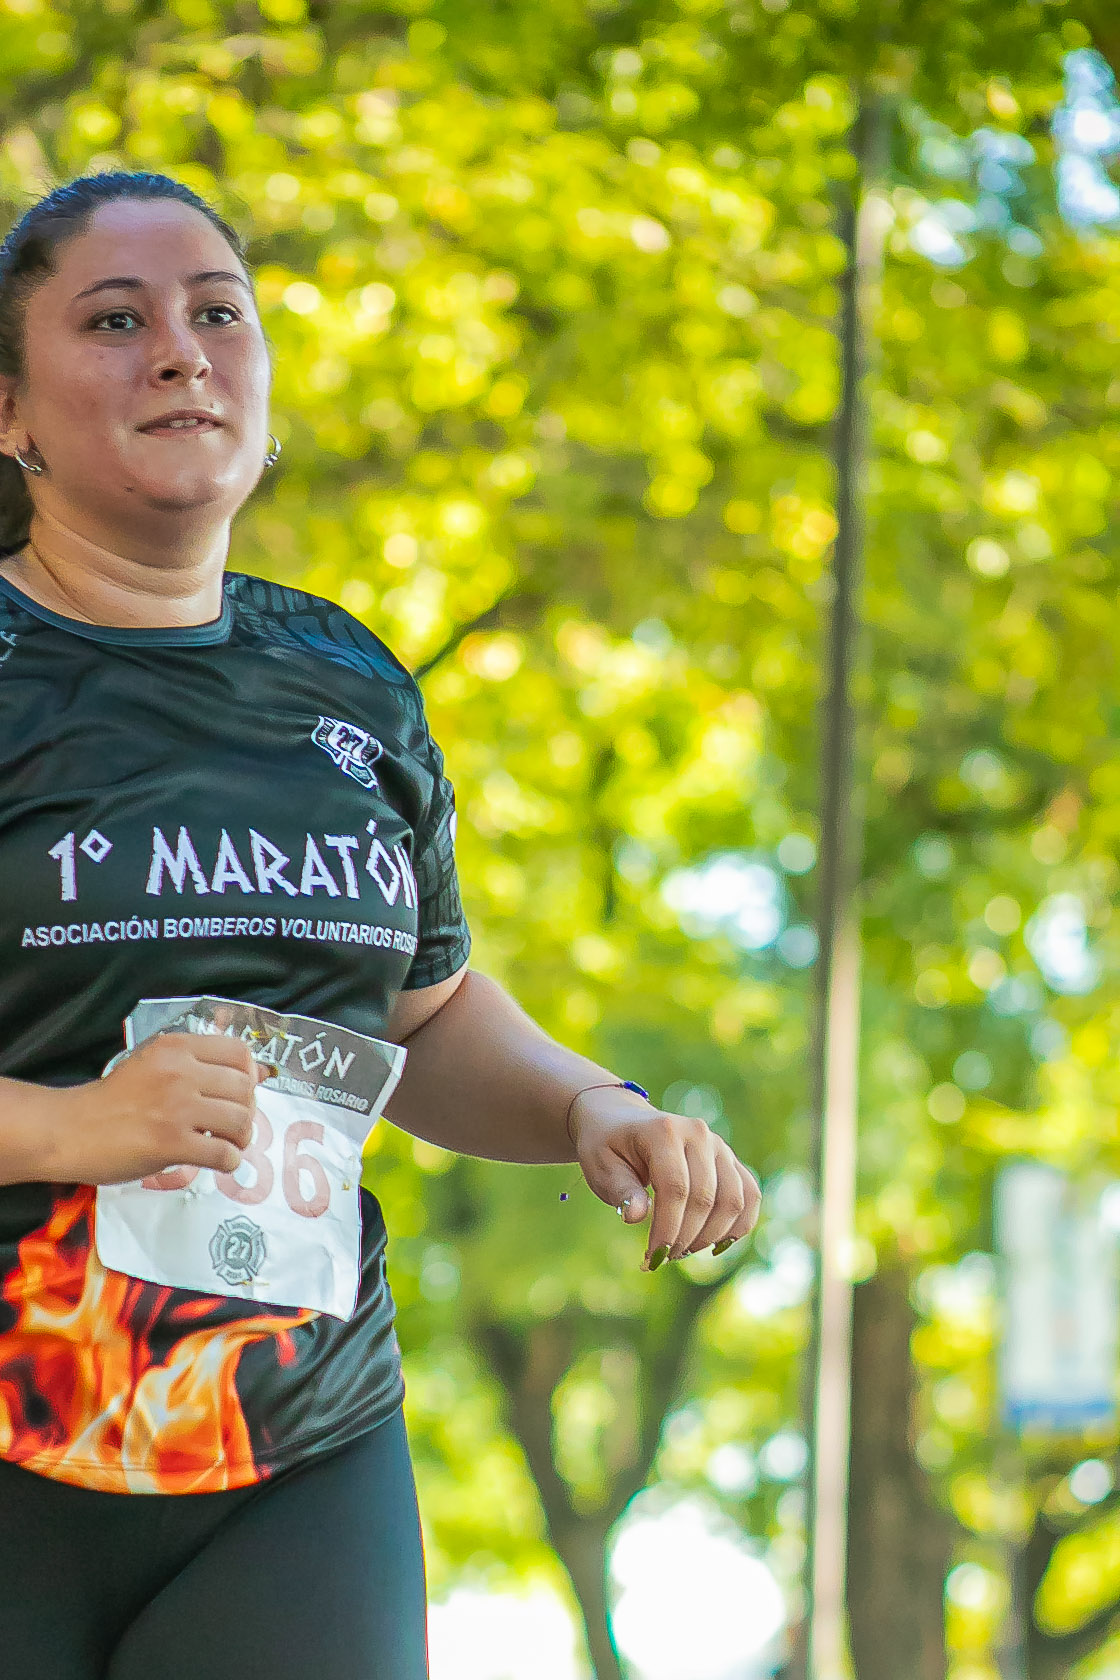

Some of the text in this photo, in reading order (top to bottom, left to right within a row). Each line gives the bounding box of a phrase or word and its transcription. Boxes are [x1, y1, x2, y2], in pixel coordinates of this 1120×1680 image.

[145, 818, 419, 912] MARATÓN
[21, 915, 159, 948] ASOCIACIÓN
[163, 916, 277, 939] BOMBEROS
[280, 917, 394, 949] VOLUNTARIOS
[315, 1084, 369, 1112] ROSARIO
